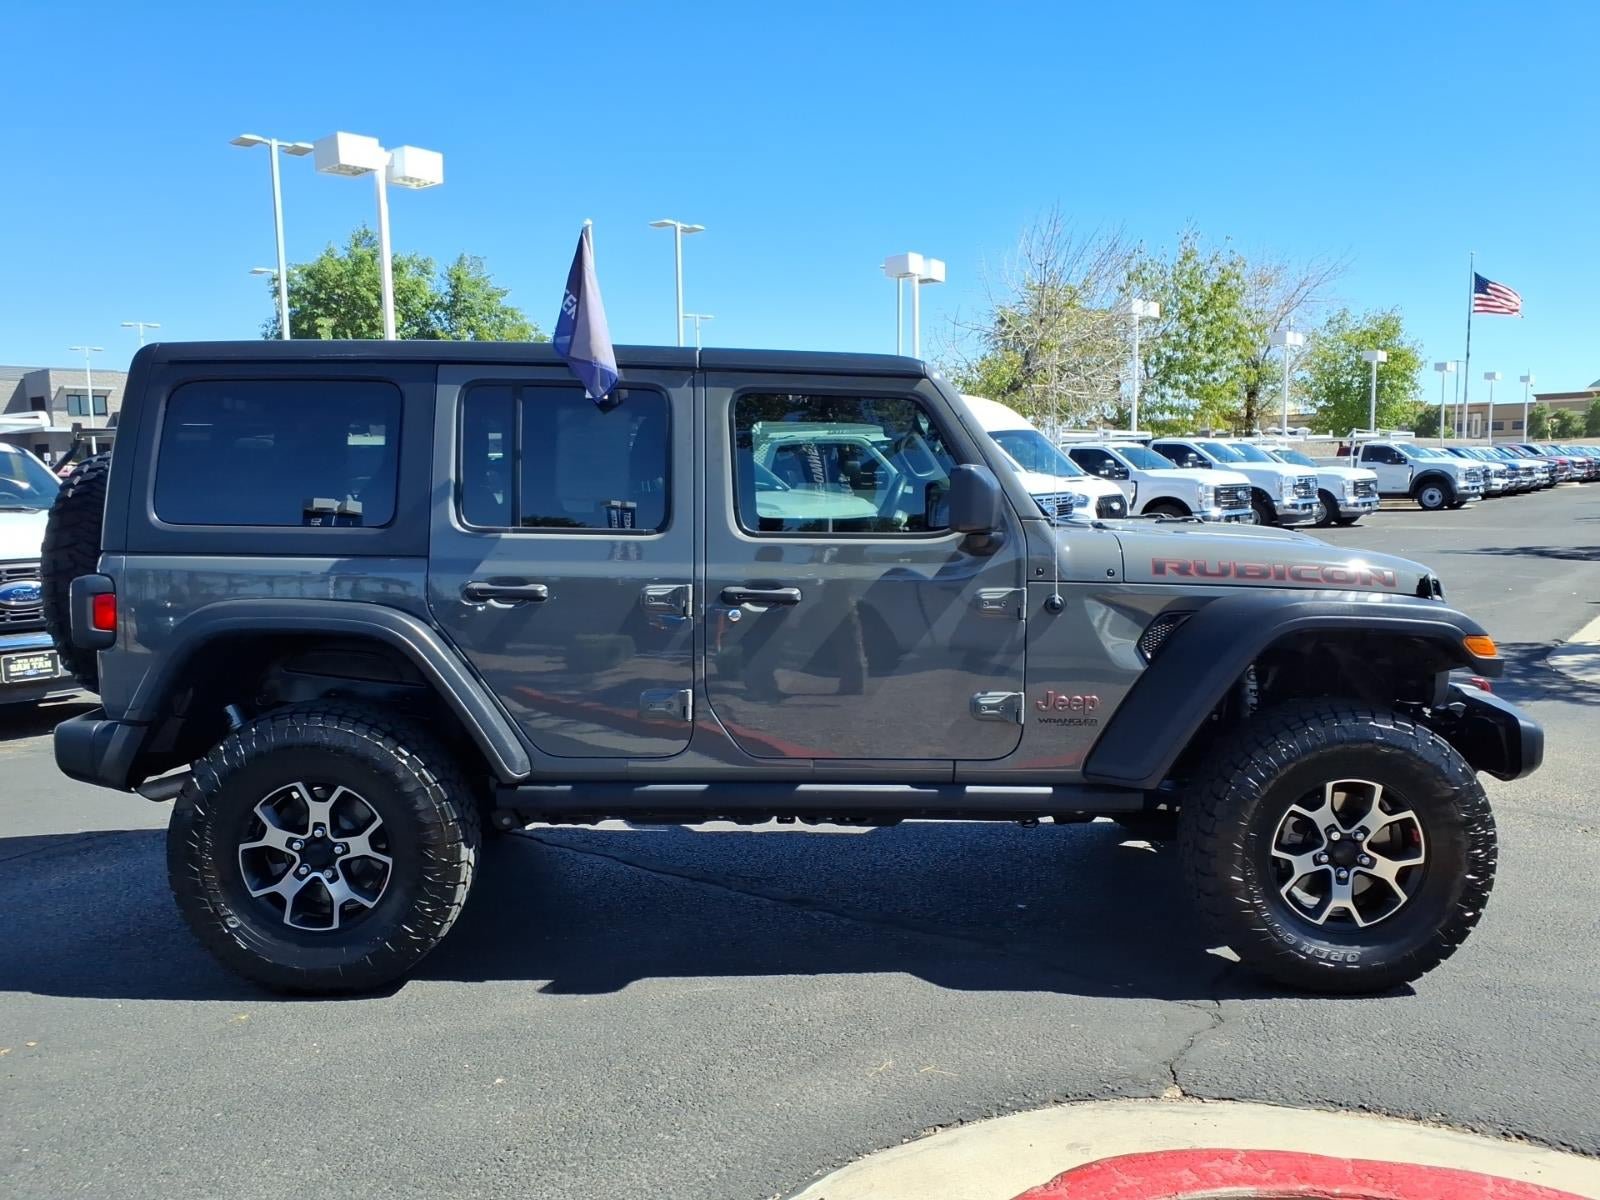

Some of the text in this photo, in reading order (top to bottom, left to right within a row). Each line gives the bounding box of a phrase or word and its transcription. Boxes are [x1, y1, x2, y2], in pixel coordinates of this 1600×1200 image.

[1152, 558, 1396, 587] RUBICON
[9, 660, 52, 672] SAN TAN
[1036, 690, 1099, 715] Jeep
[1299, 943, 1360, 963] OPEN
